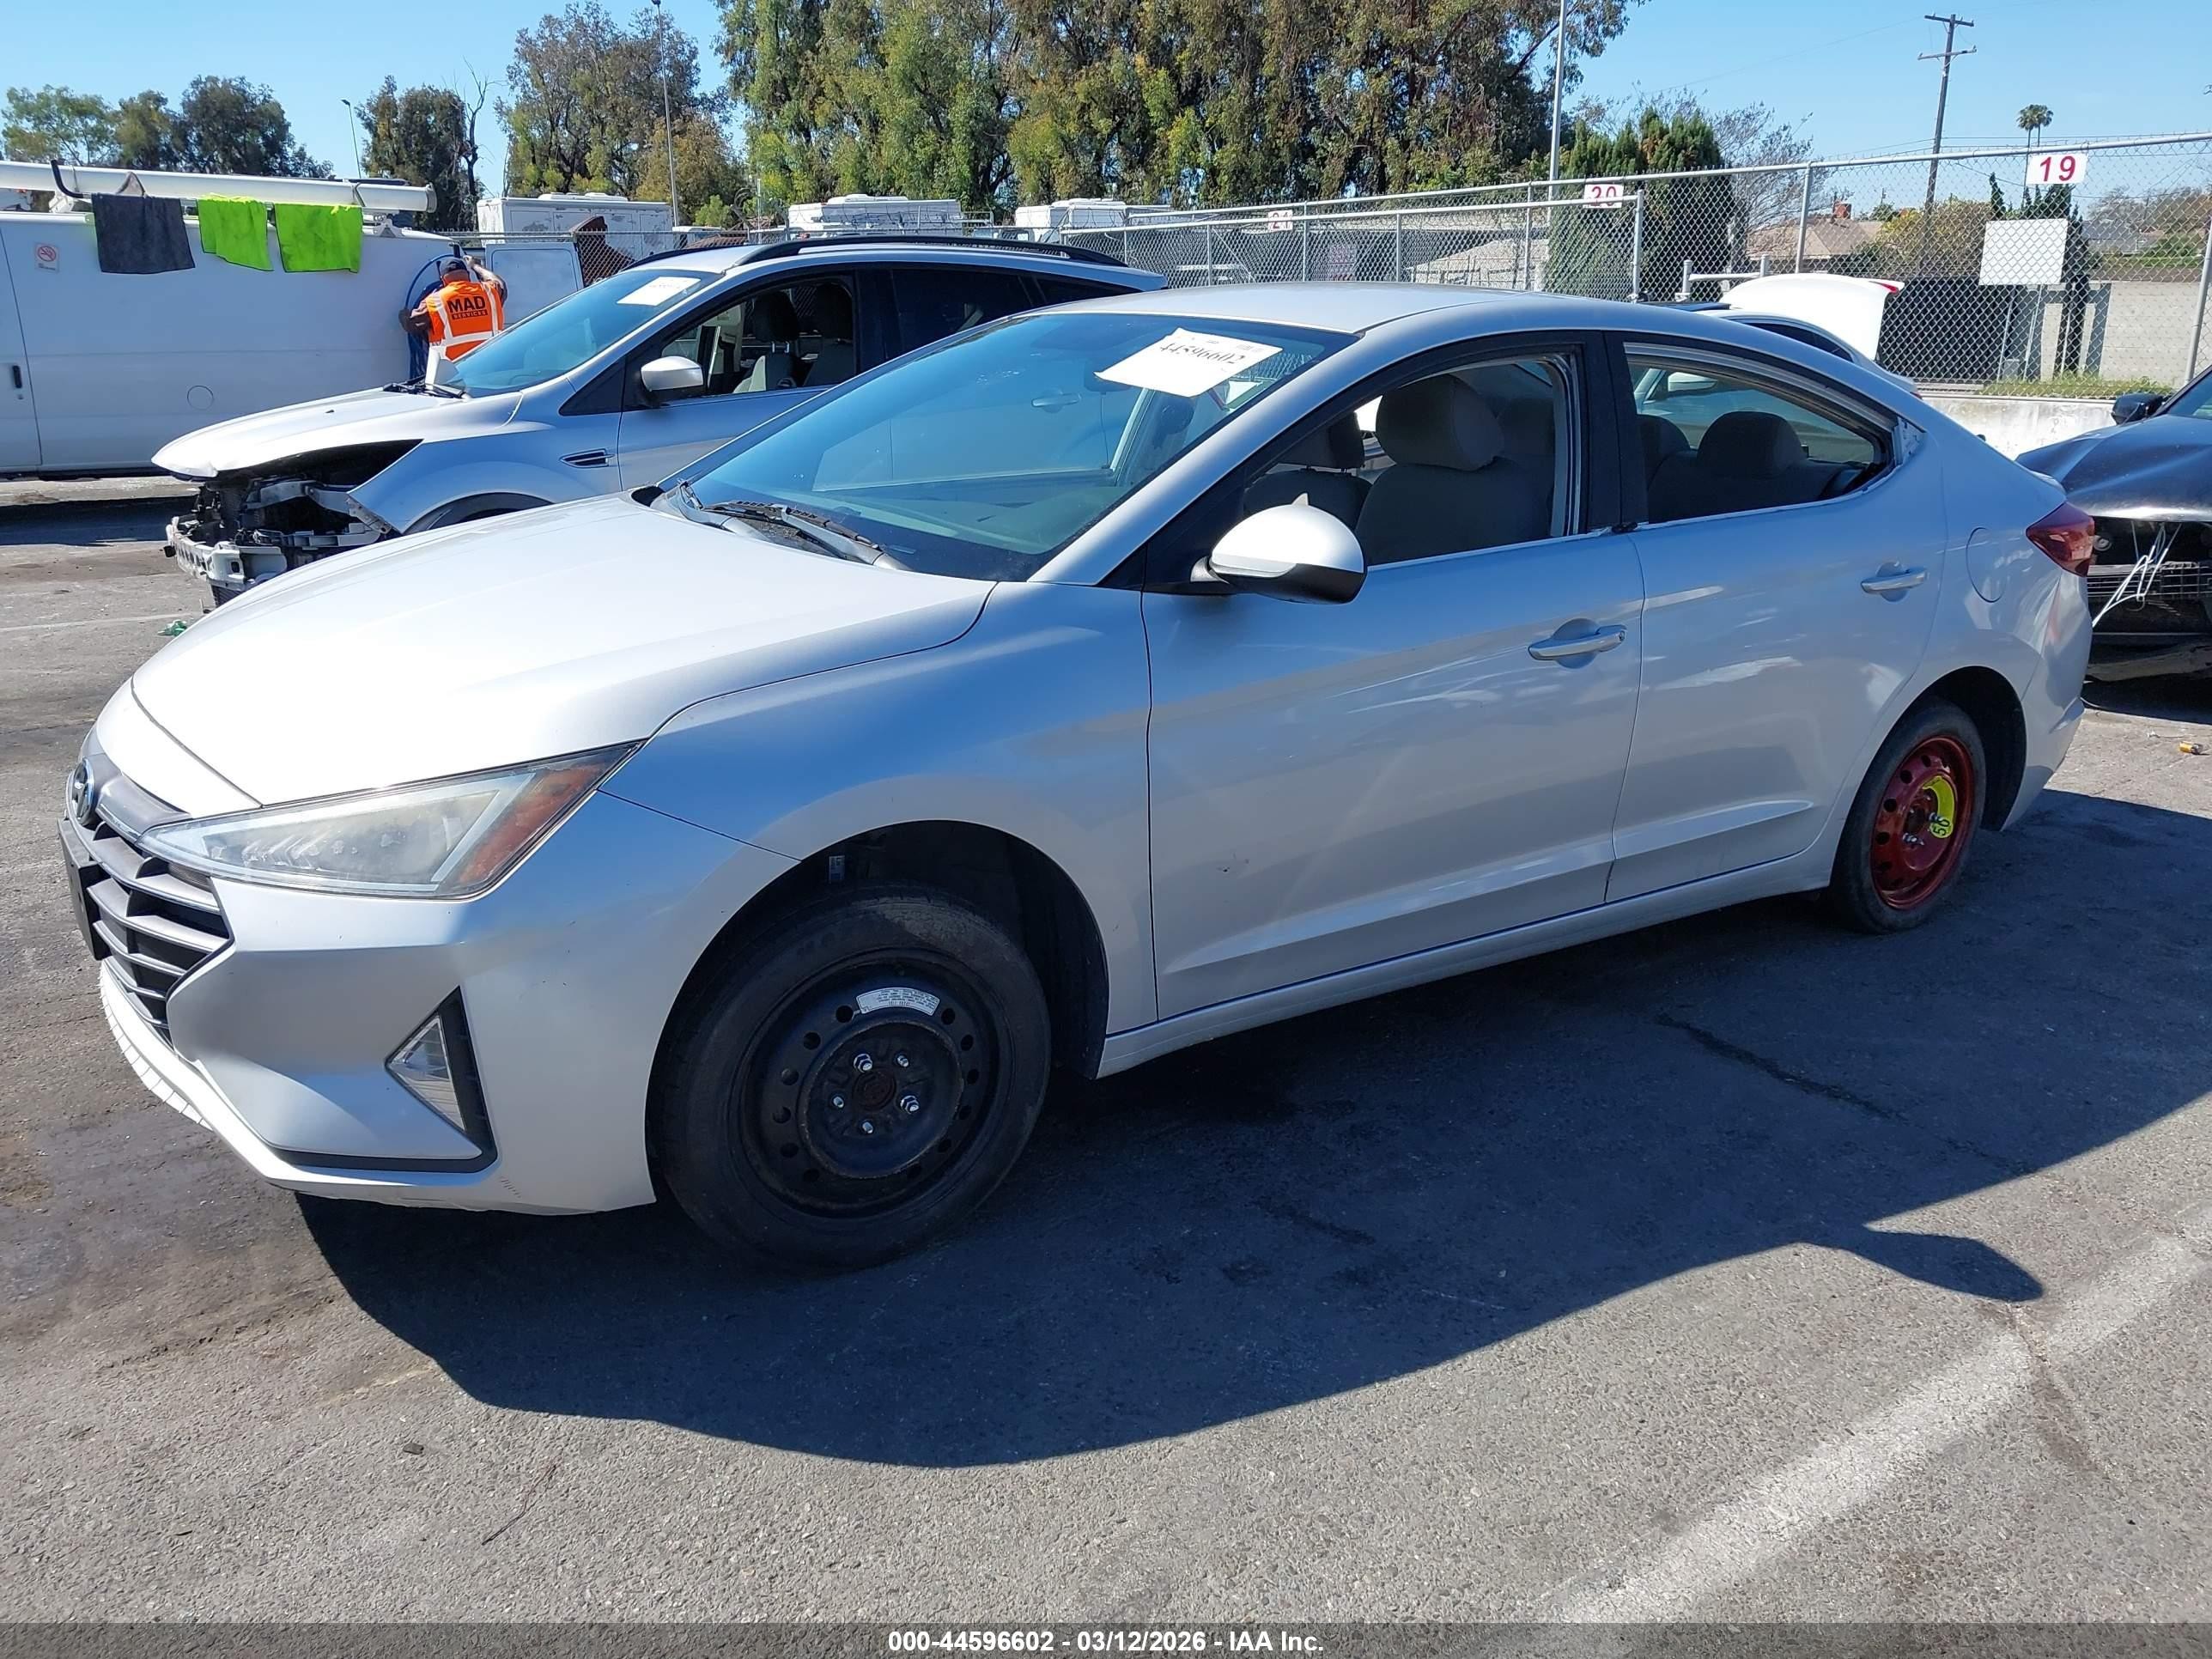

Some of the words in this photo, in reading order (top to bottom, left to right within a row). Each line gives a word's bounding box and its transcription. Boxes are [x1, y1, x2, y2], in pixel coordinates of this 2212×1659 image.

[2040, 155, 2075, 182] 19
[1592, 185, 1616, 207] 20
[447, 295, 486, 313] MAD
[453, 310, 488, 319] SERVICES
[1160, 343, 1246, 364] 44596602
